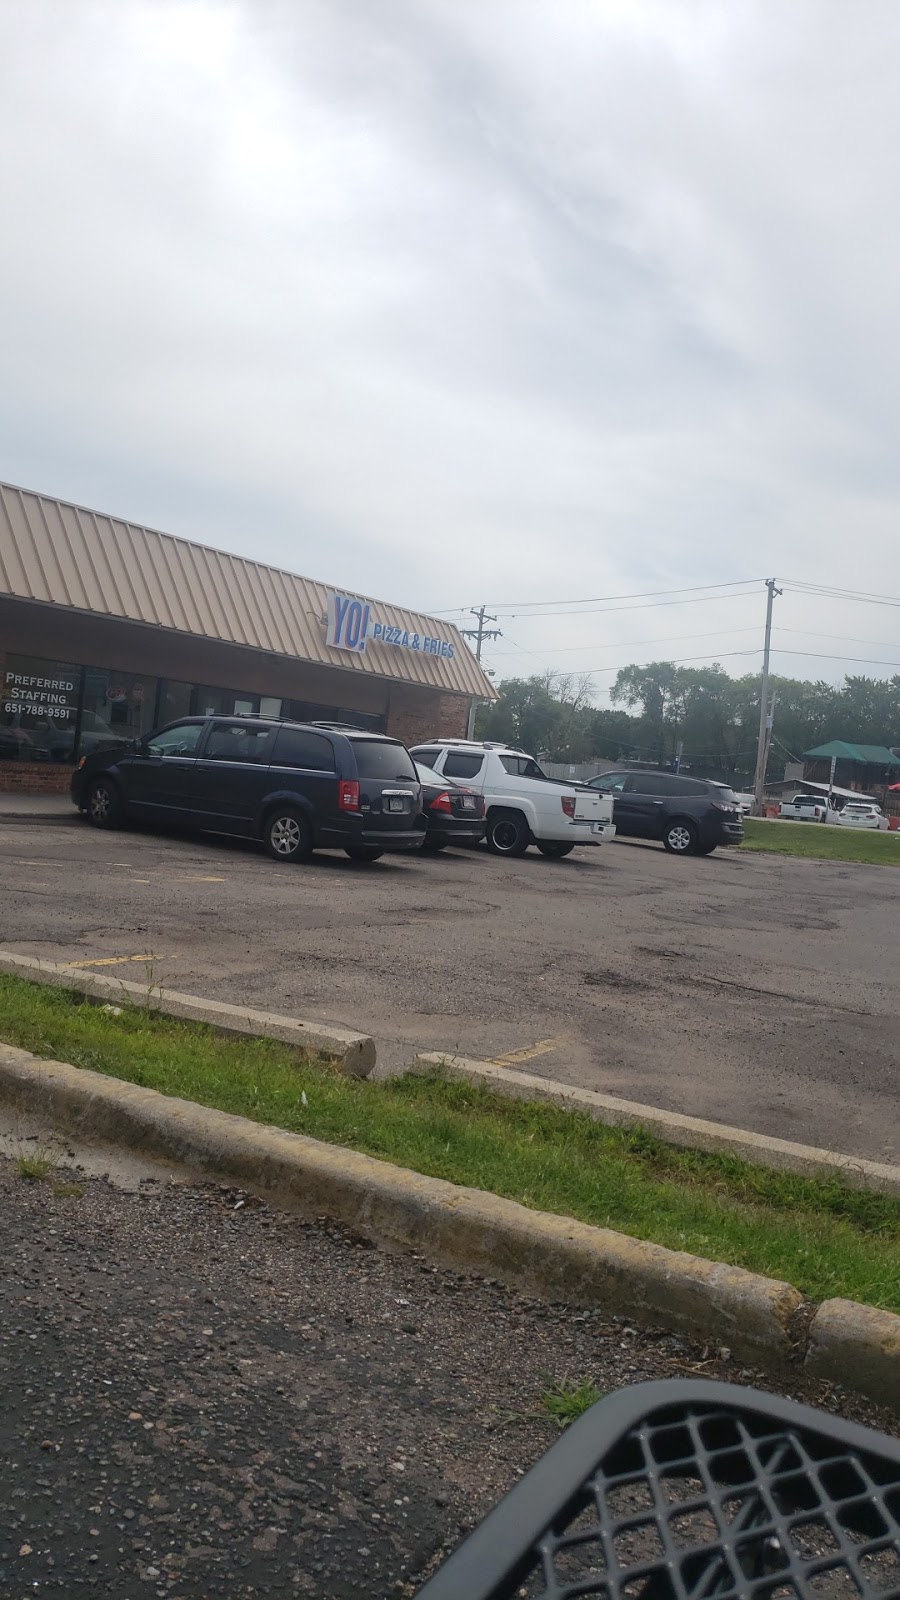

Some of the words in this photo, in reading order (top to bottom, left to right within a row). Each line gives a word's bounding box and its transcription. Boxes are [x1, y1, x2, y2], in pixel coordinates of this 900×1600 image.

[334, 596, 370, 650] YO!
[373, 623, 409, 647] PIZZA
[411, 633, 420, 650] &
[423, 635, 455, 659] FRIES
[6, 672, 74, 691] PREFERRED
[11, 687, 67, 704] STAFFING
[4, 702, 70, 719] 651-788-9591
